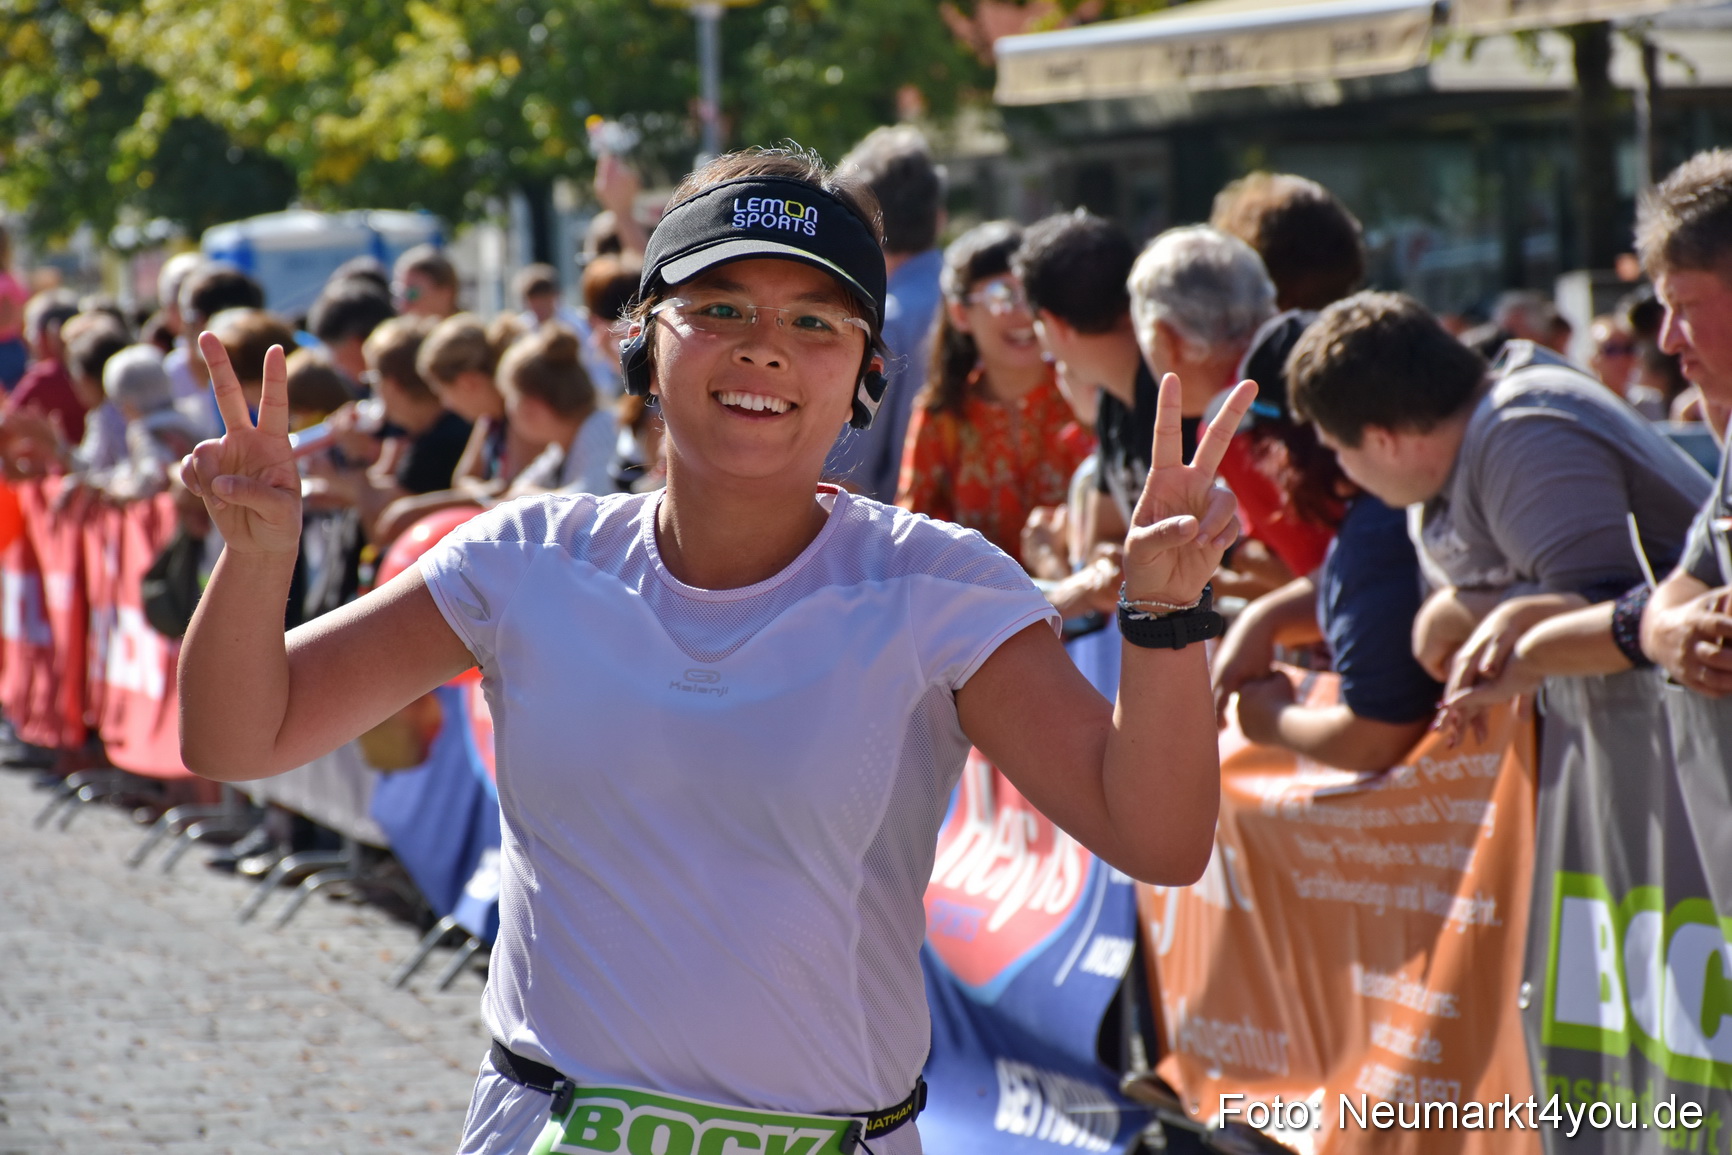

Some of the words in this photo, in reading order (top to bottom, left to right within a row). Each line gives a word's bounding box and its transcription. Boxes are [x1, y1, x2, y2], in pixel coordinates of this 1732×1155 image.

[733, 197, 818, 223] LEMON
[731, 212, 816, 236] SPORTS
[865, 1102, 913, 1131] NATHAN
